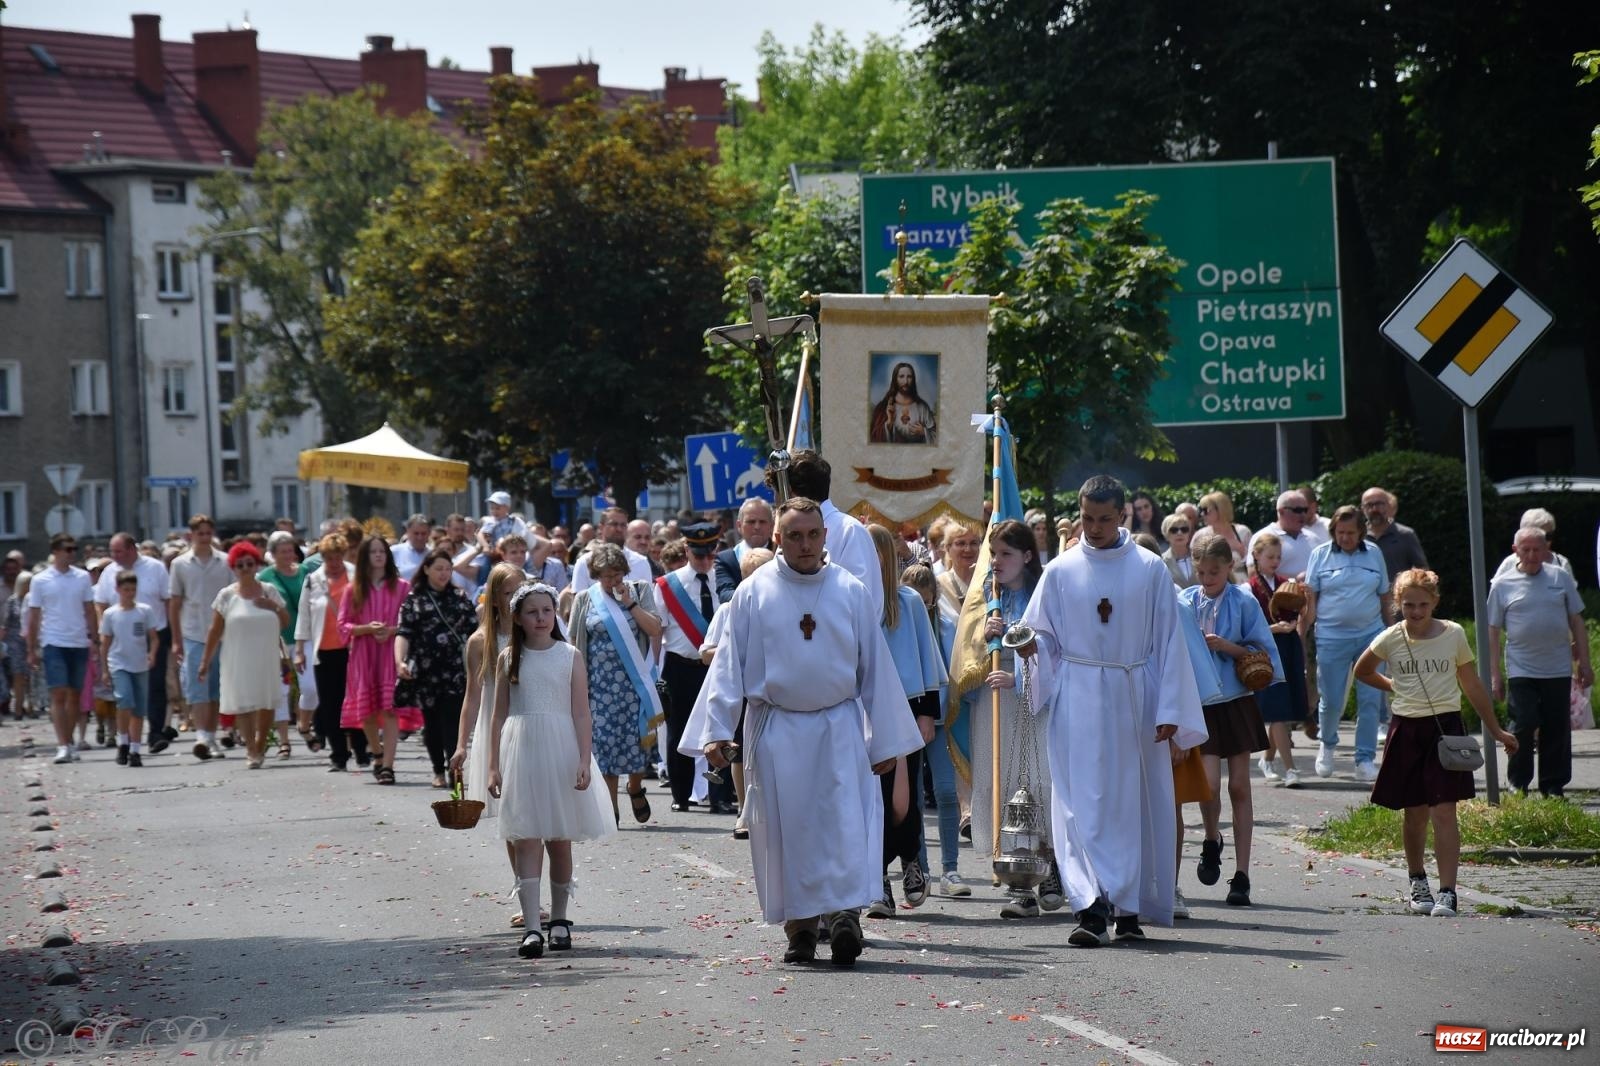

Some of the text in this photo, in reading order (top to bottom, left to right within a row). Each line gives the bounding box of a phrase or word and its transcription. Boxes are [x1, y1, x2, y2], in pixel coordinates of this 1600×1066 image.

[931, 182, 1018, 215] Rybnik
[885, 223, 969, 248] Tanzyt
[1197, 261, 1282, 292] Opole
[1197, 299, 1332, 326] Pietraszyn
[1199, 332, 1276, 356] Opava
[1200, 357, 1326, 388] Chałupki
[1202, 394, 1291, 413] Ostrava
[1398, 659, 1450, 674] MILANO
